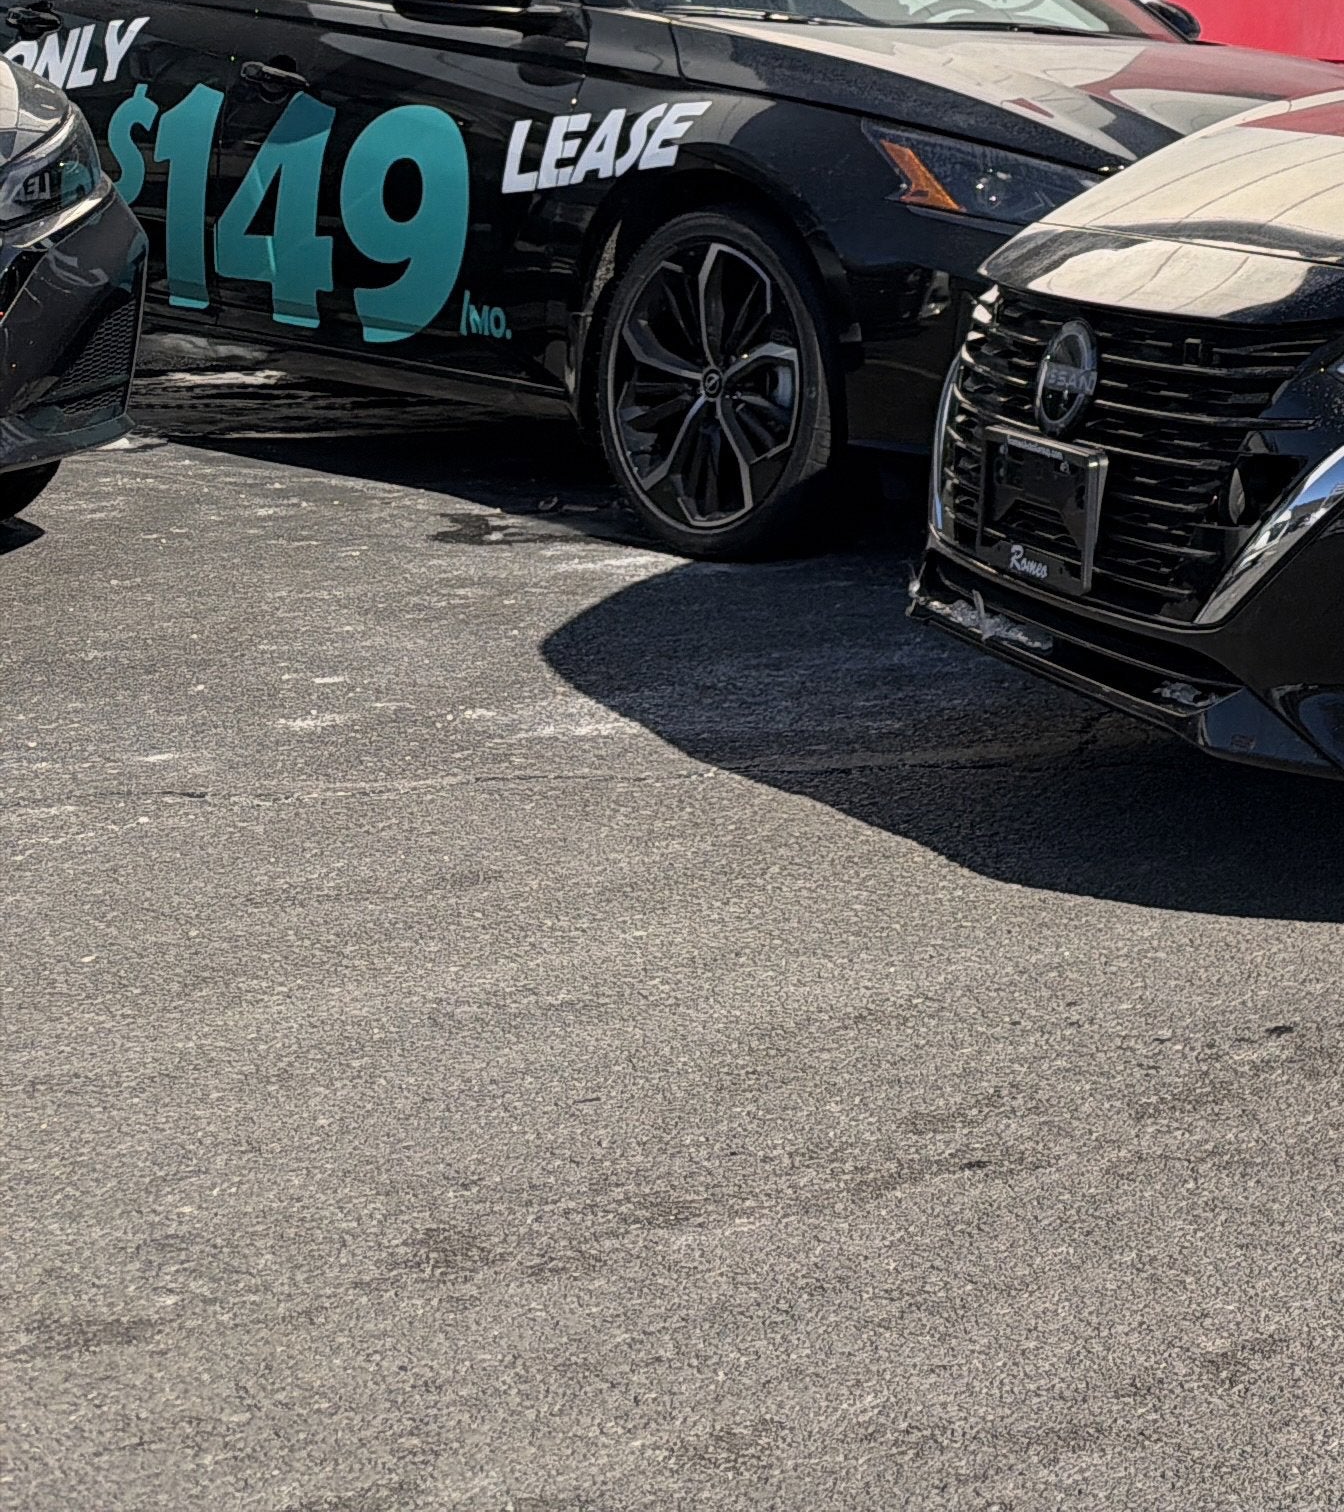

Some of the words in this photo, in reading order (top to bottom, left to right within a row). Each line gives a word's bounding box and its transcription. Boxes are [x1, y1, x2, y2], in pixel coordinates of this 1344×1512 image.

[502, 100, 713, 194] LEASE
[108, 83, 470, 344] $149
[459, 289, 512, 340] /MO.
[1010, 544, 1048, 579] Romeo
